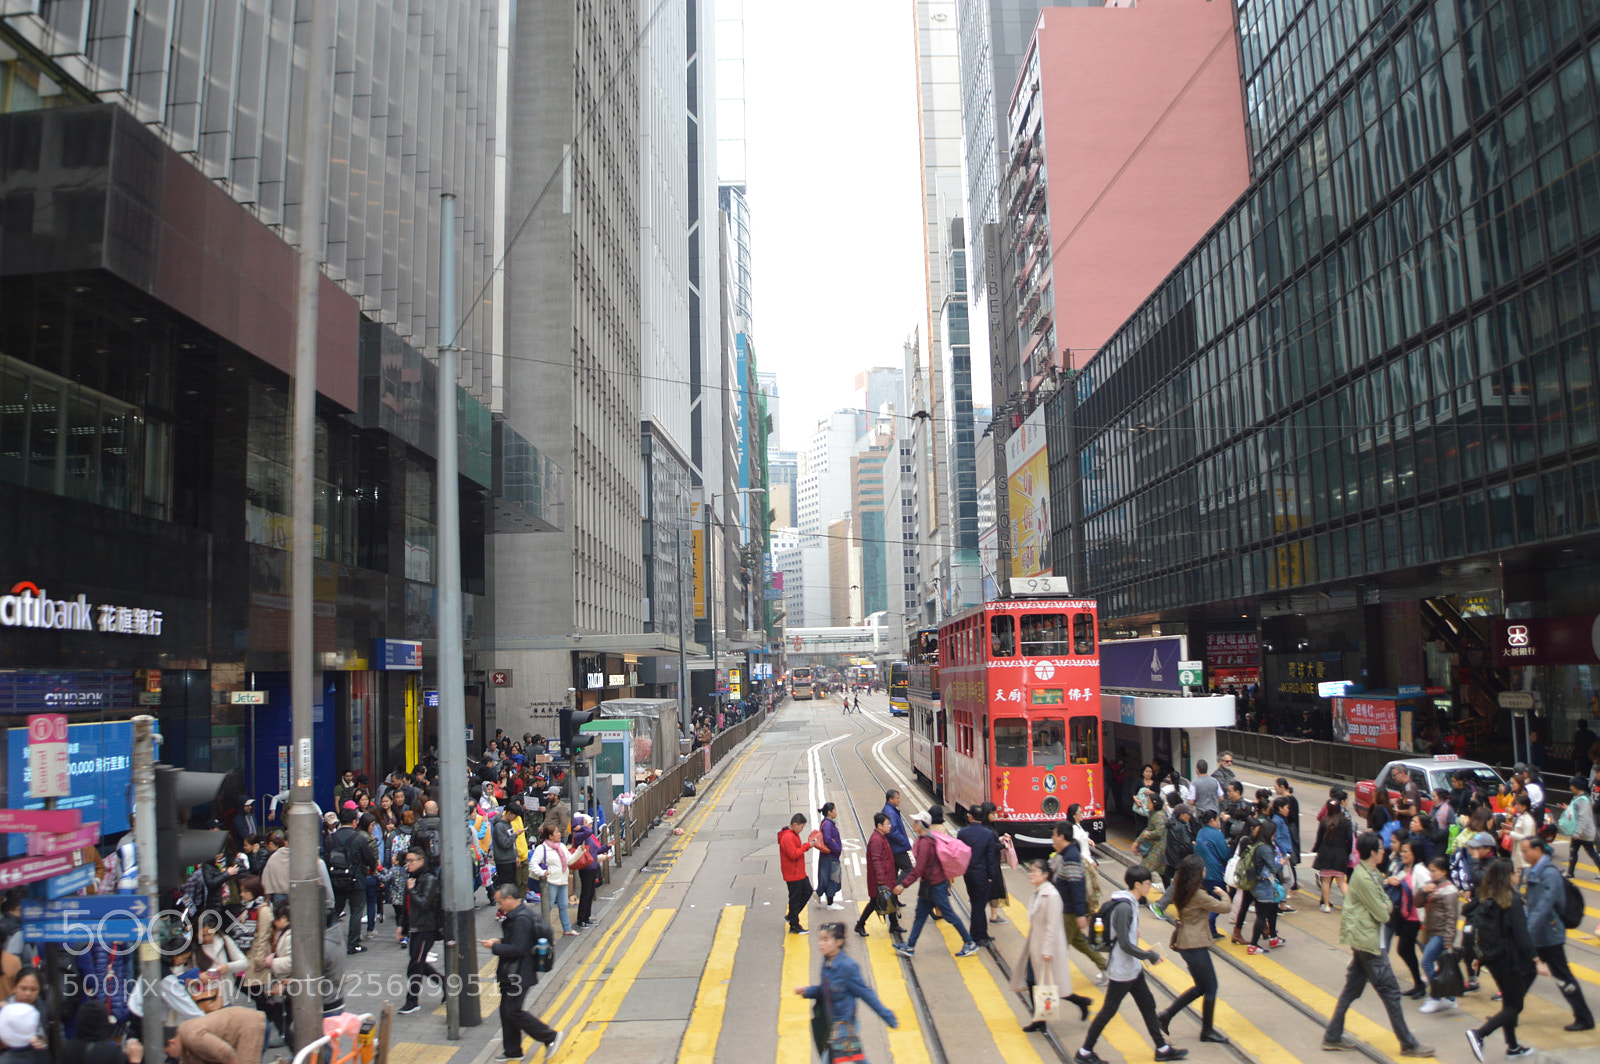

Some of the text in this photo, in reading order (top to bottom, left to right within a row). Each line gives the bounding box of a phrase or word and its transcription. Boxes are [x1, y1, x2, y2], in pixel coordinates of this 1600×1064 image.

[987, 246, 1003, 387] SIBERIAN
[998, 476, 1011, 559] STOR
[1027, 578, 1051, 592] 93
[0, 587, 92, 631] citibank
[995, 605, 1006, 614] 93
[97, 604, 163, 636] 花旗銀行
[1502, 647, 1537, 657] 大新銀行
[994, 688, 1022, 703] 天廚
[1068, 687, 1093, 702] 佛手
[1092, 821, 1104, 830] 93
